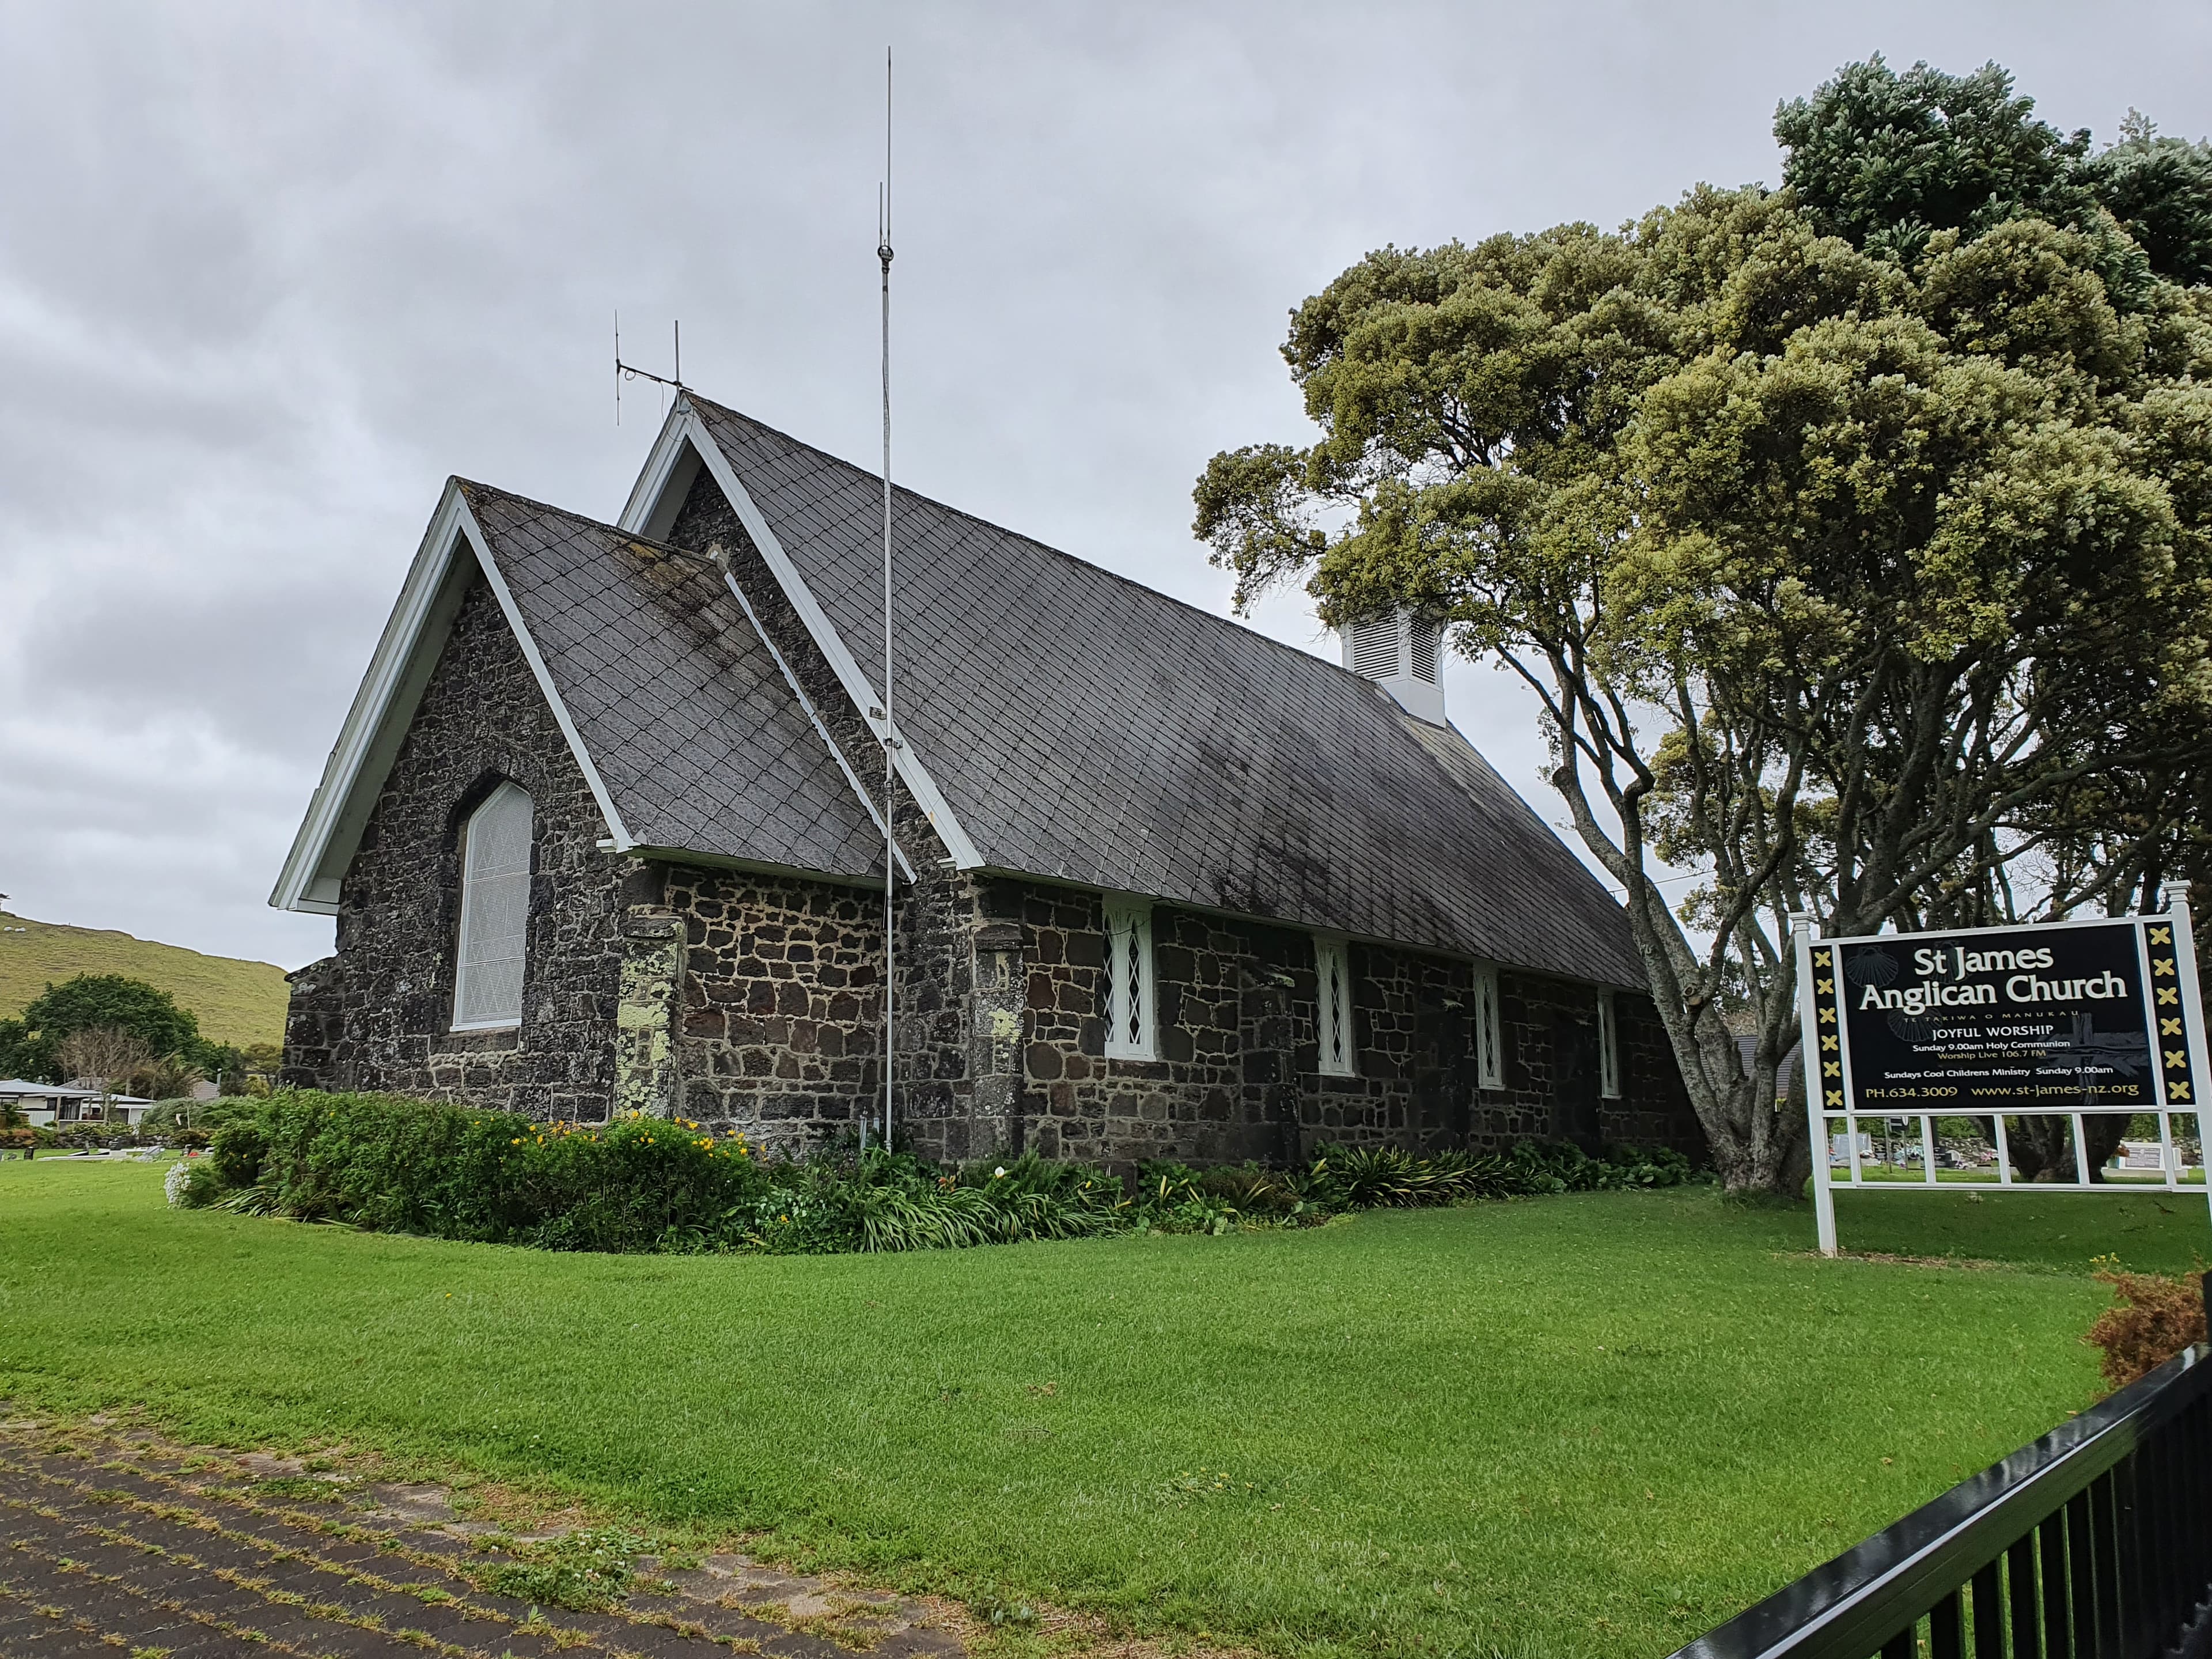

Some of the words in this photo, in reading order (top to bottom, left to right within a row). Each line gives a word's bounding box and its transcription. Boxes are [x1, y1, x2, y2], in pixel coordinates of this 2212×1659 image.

[1914, 948, 1948, 975] St
[1955, 946, 2054, 980] James
[1859, 980, 1998, 1016] Anglican
[2006, 970, 2128, 1002] Church
[2002, 1010, 2078, 1018] MANUKAU
[1932, 1028, 1981, 1041] JOYFUL
[1986, 1025, 2054, 1037] WORSHIP
[1912, 1044, 1946, 1052] Sunday
[1986, 1042, 2009, 1050] Holy
[2010, 1040, 2071, 1048] Communion
[1992, 1067, 2031, 1077] Ministry
[2036, 1067, 2073, 1075] Sunday
[1866, 1086, 1958, 1098] PH.634.3009
[1971, 1084, 2139, 1097] www.st-james-nz.org
